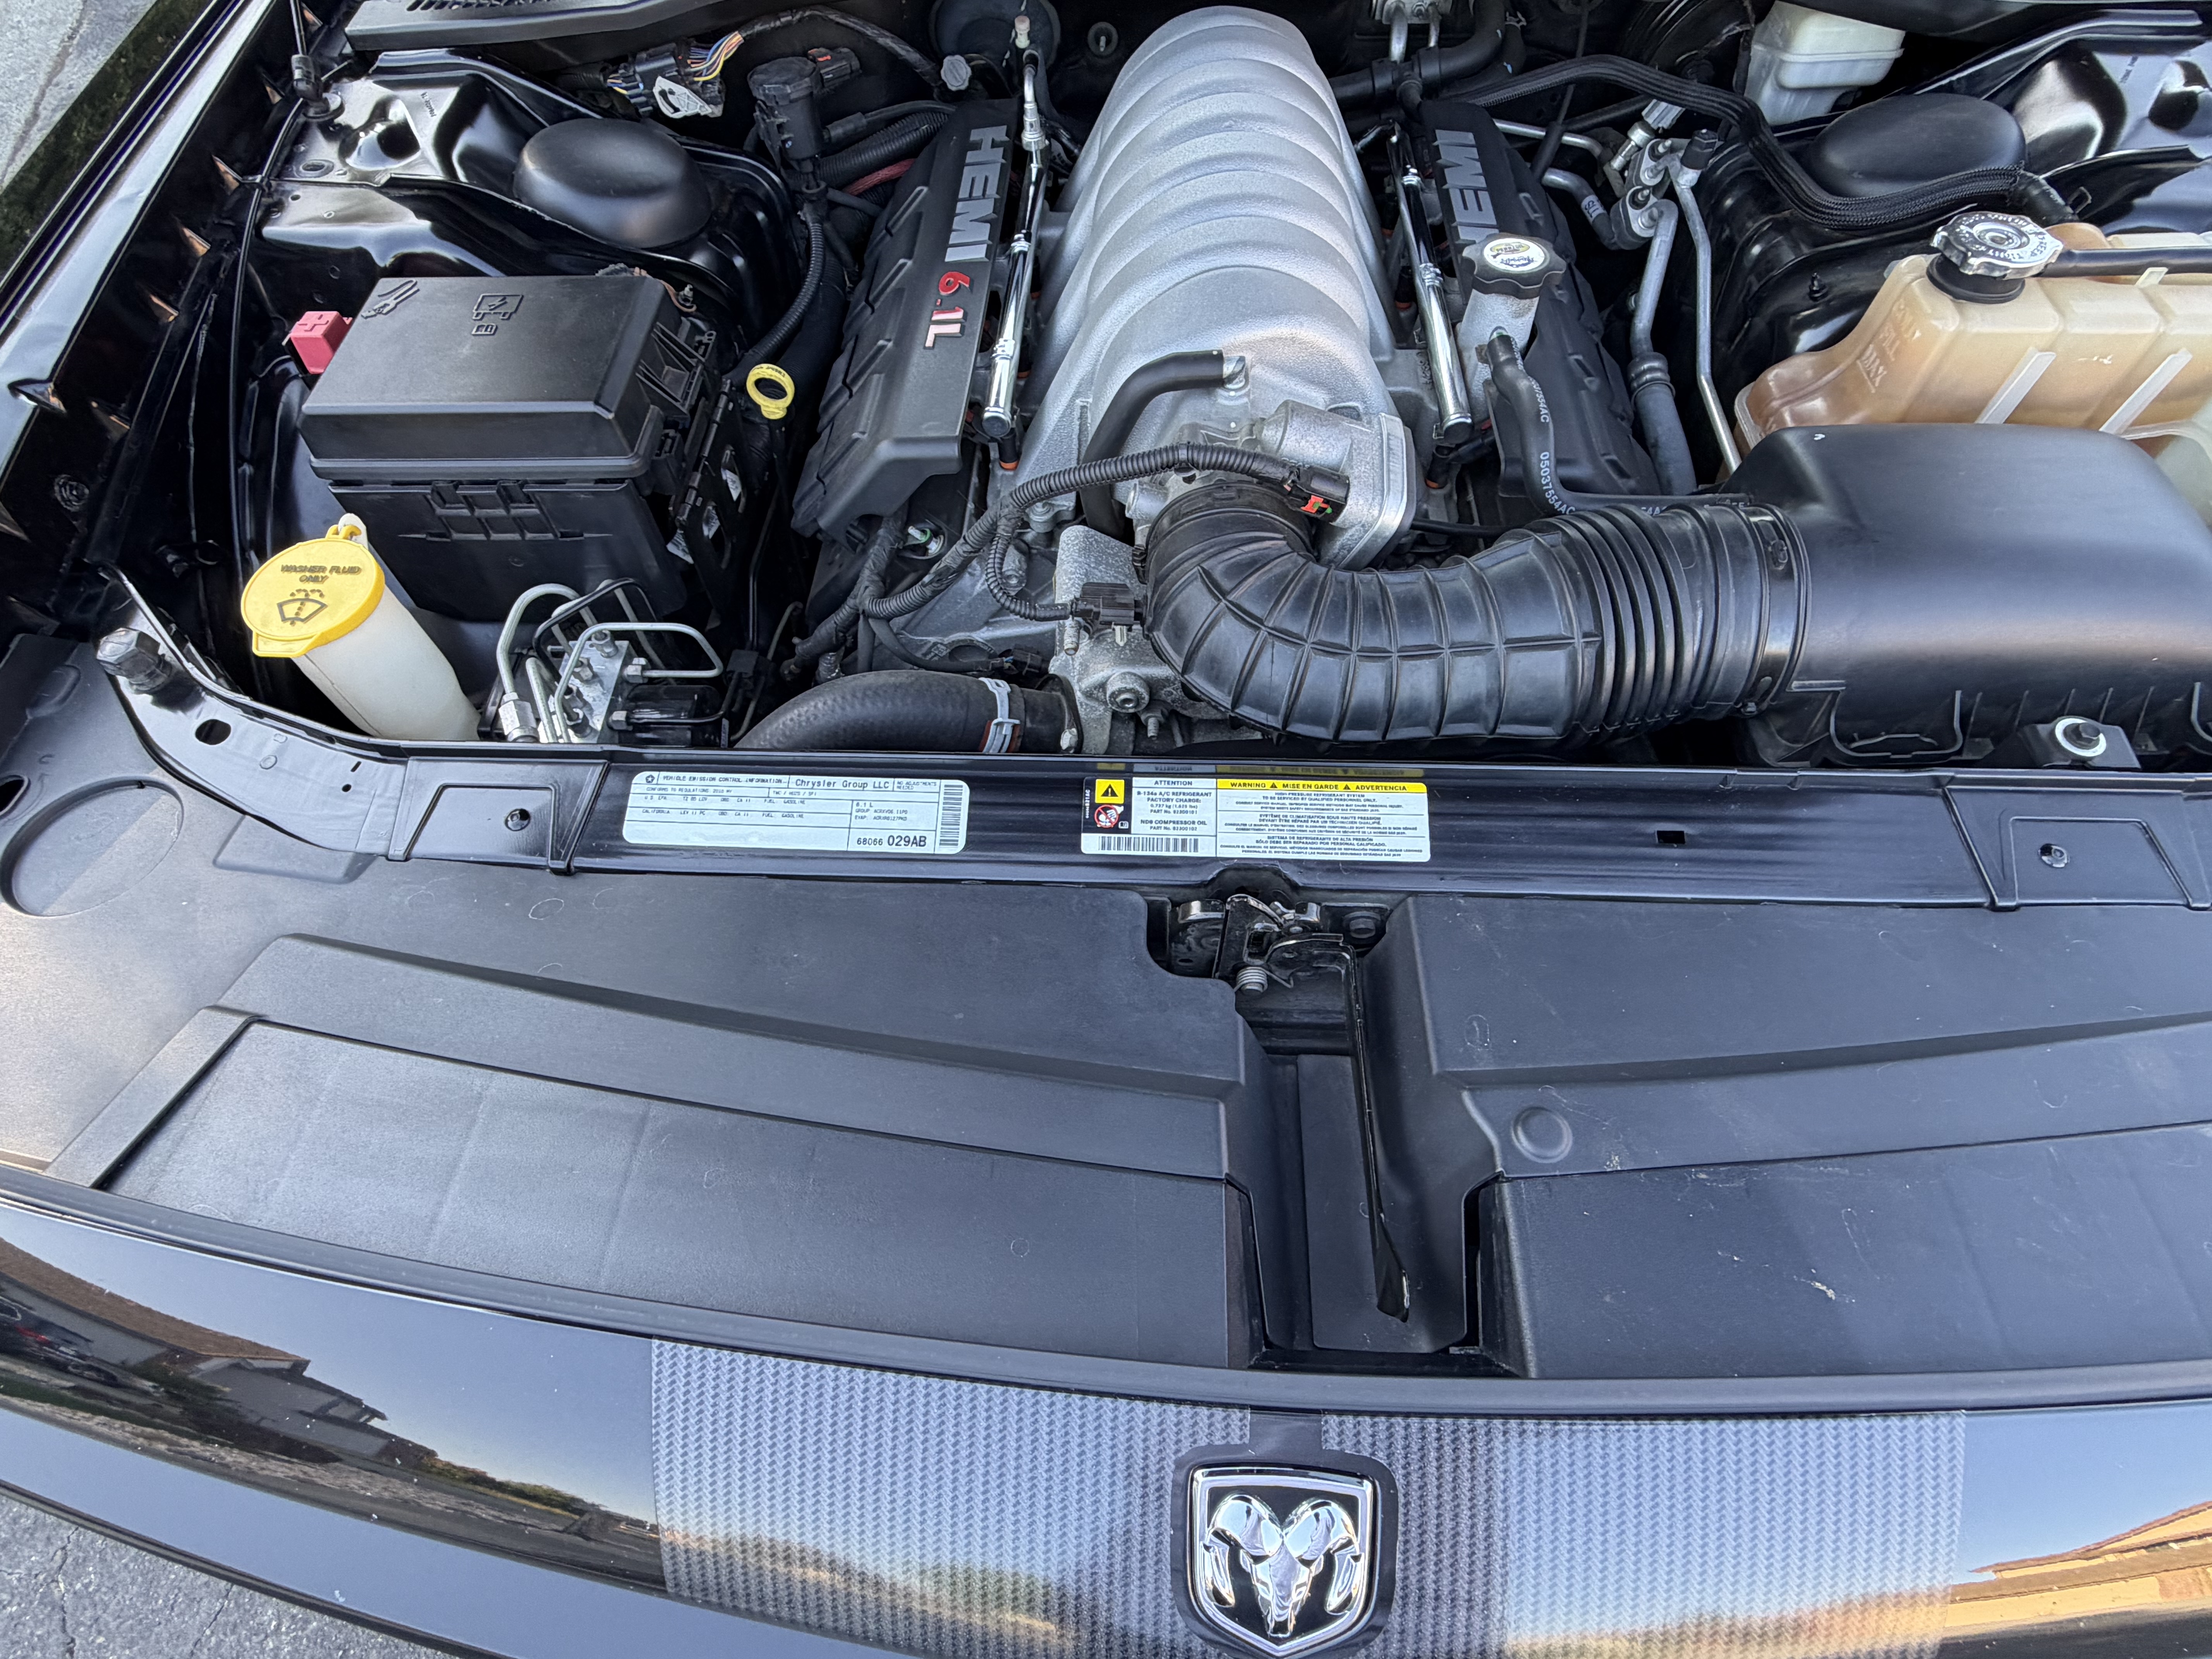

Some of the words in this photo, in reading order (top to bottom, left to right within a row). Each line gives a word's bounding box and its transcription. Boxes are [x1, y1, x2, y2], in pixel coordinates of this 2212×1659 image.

[945, 127, 1009, 262] HEMI
[923, 271, 974, 350] 6.1L
[1539, 452, 1576, 515] 05037554AC
[280, 564, 328, 574] WASHER
[329, 565, 363, 575] FLUID
[299, 575, 329, 584] ONLY
[795, 779, 836, 788] Chrysler
[842, 781, 868, 791] Group
[857, 837, 883, 846] 68066
[887, 835, 927, 847] 029AB
